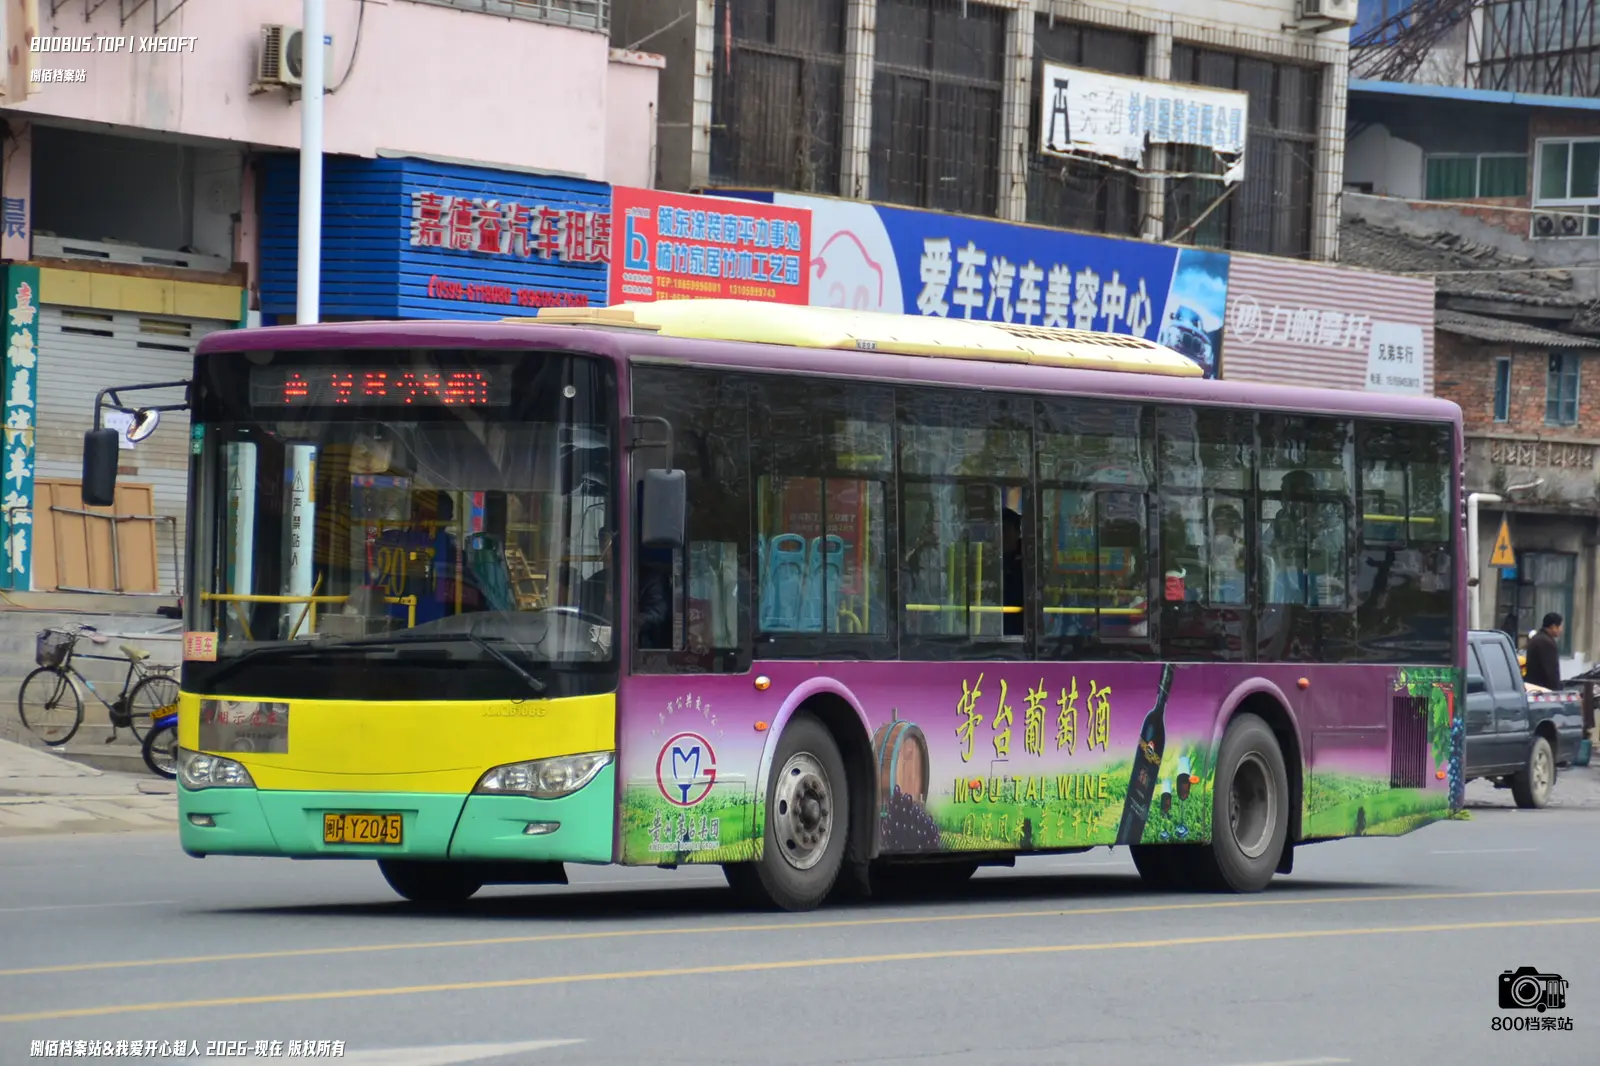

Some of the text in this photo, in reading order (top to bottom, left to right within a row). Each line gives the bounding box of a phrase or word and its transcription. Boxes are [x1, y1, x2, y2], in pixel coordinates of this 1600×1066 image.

[410, 191, 611, 264] 嘉德益汽车租赁
[916, 237, 1152, 338] 爱车汽车美容中心
[1378, 343, 1413, 364] 兄弟车行
[955, 672, 1113, 763] 茅台葡萄酒
[1056, 773, 1110, 801] WINE
